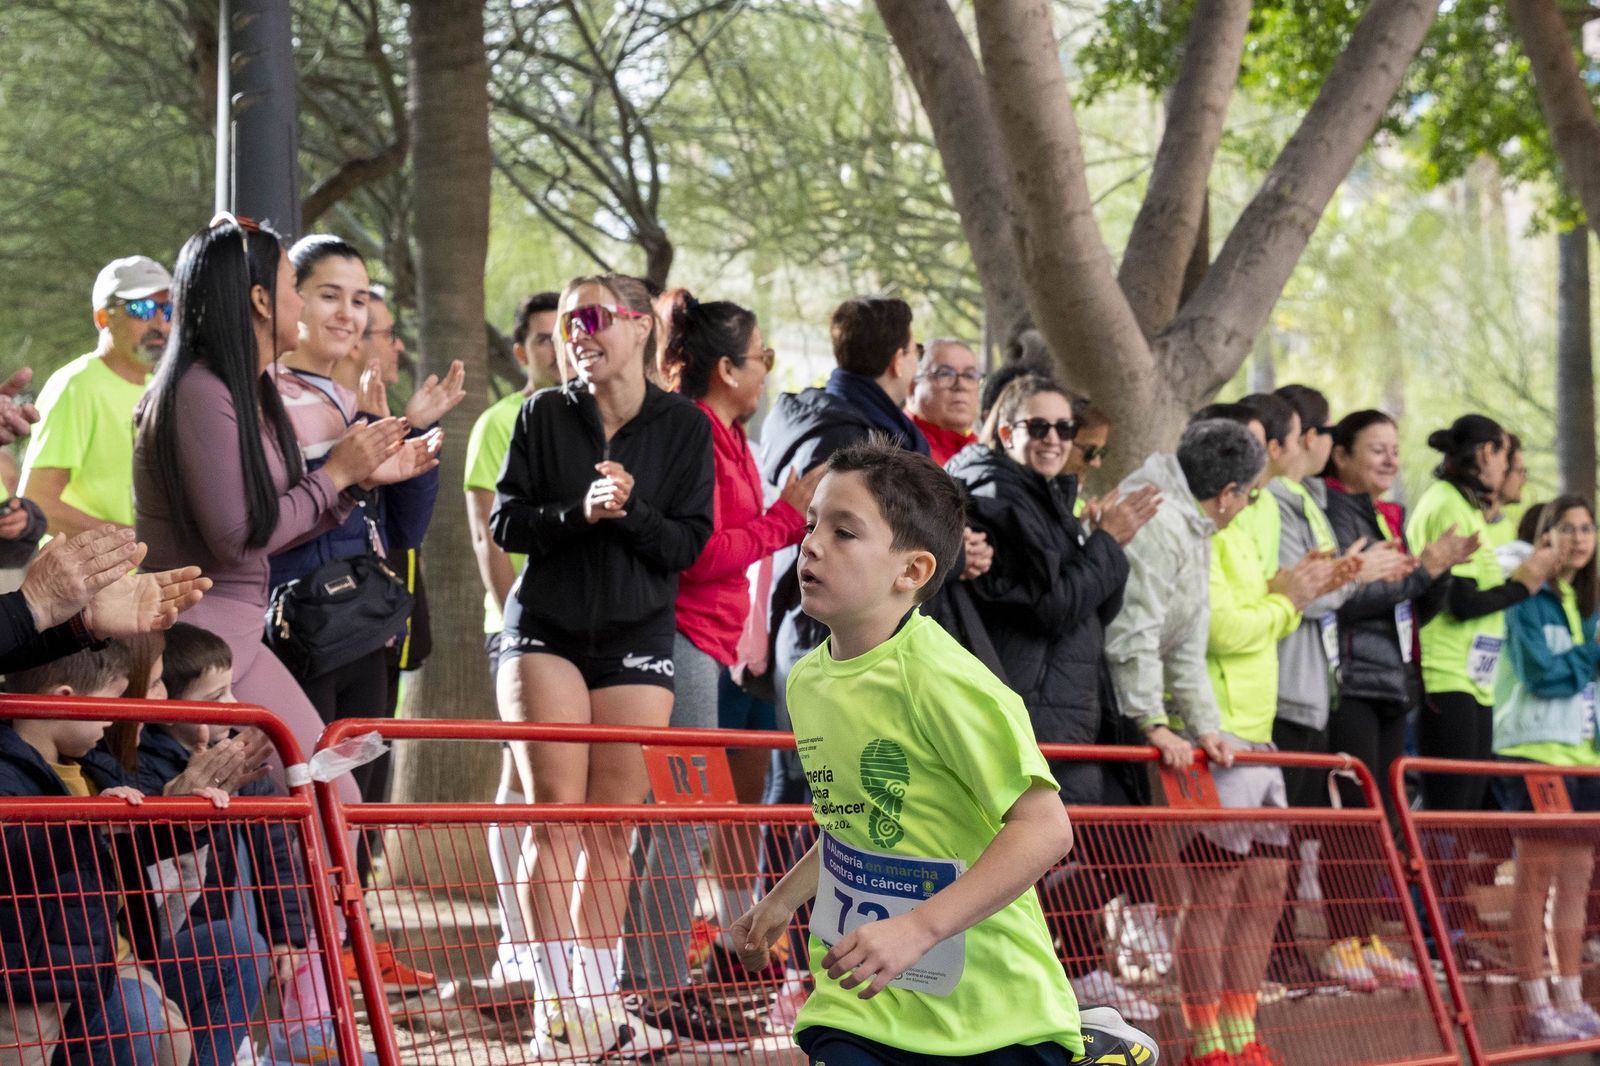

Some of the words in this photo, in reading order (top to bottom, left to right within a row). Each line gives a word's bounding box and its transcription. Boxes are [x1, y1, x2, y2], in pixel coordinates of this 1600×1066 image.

[667, 755, 709, 796] RT
[830, 858, 853, 881] contra
[855, 874, 868, 886] el
[871, 876, 918, 893] cáncer
[831, 842, 863, 869] Almería
[866, 861, 882, 873] en
[886, 864, 939, 880] marcha
